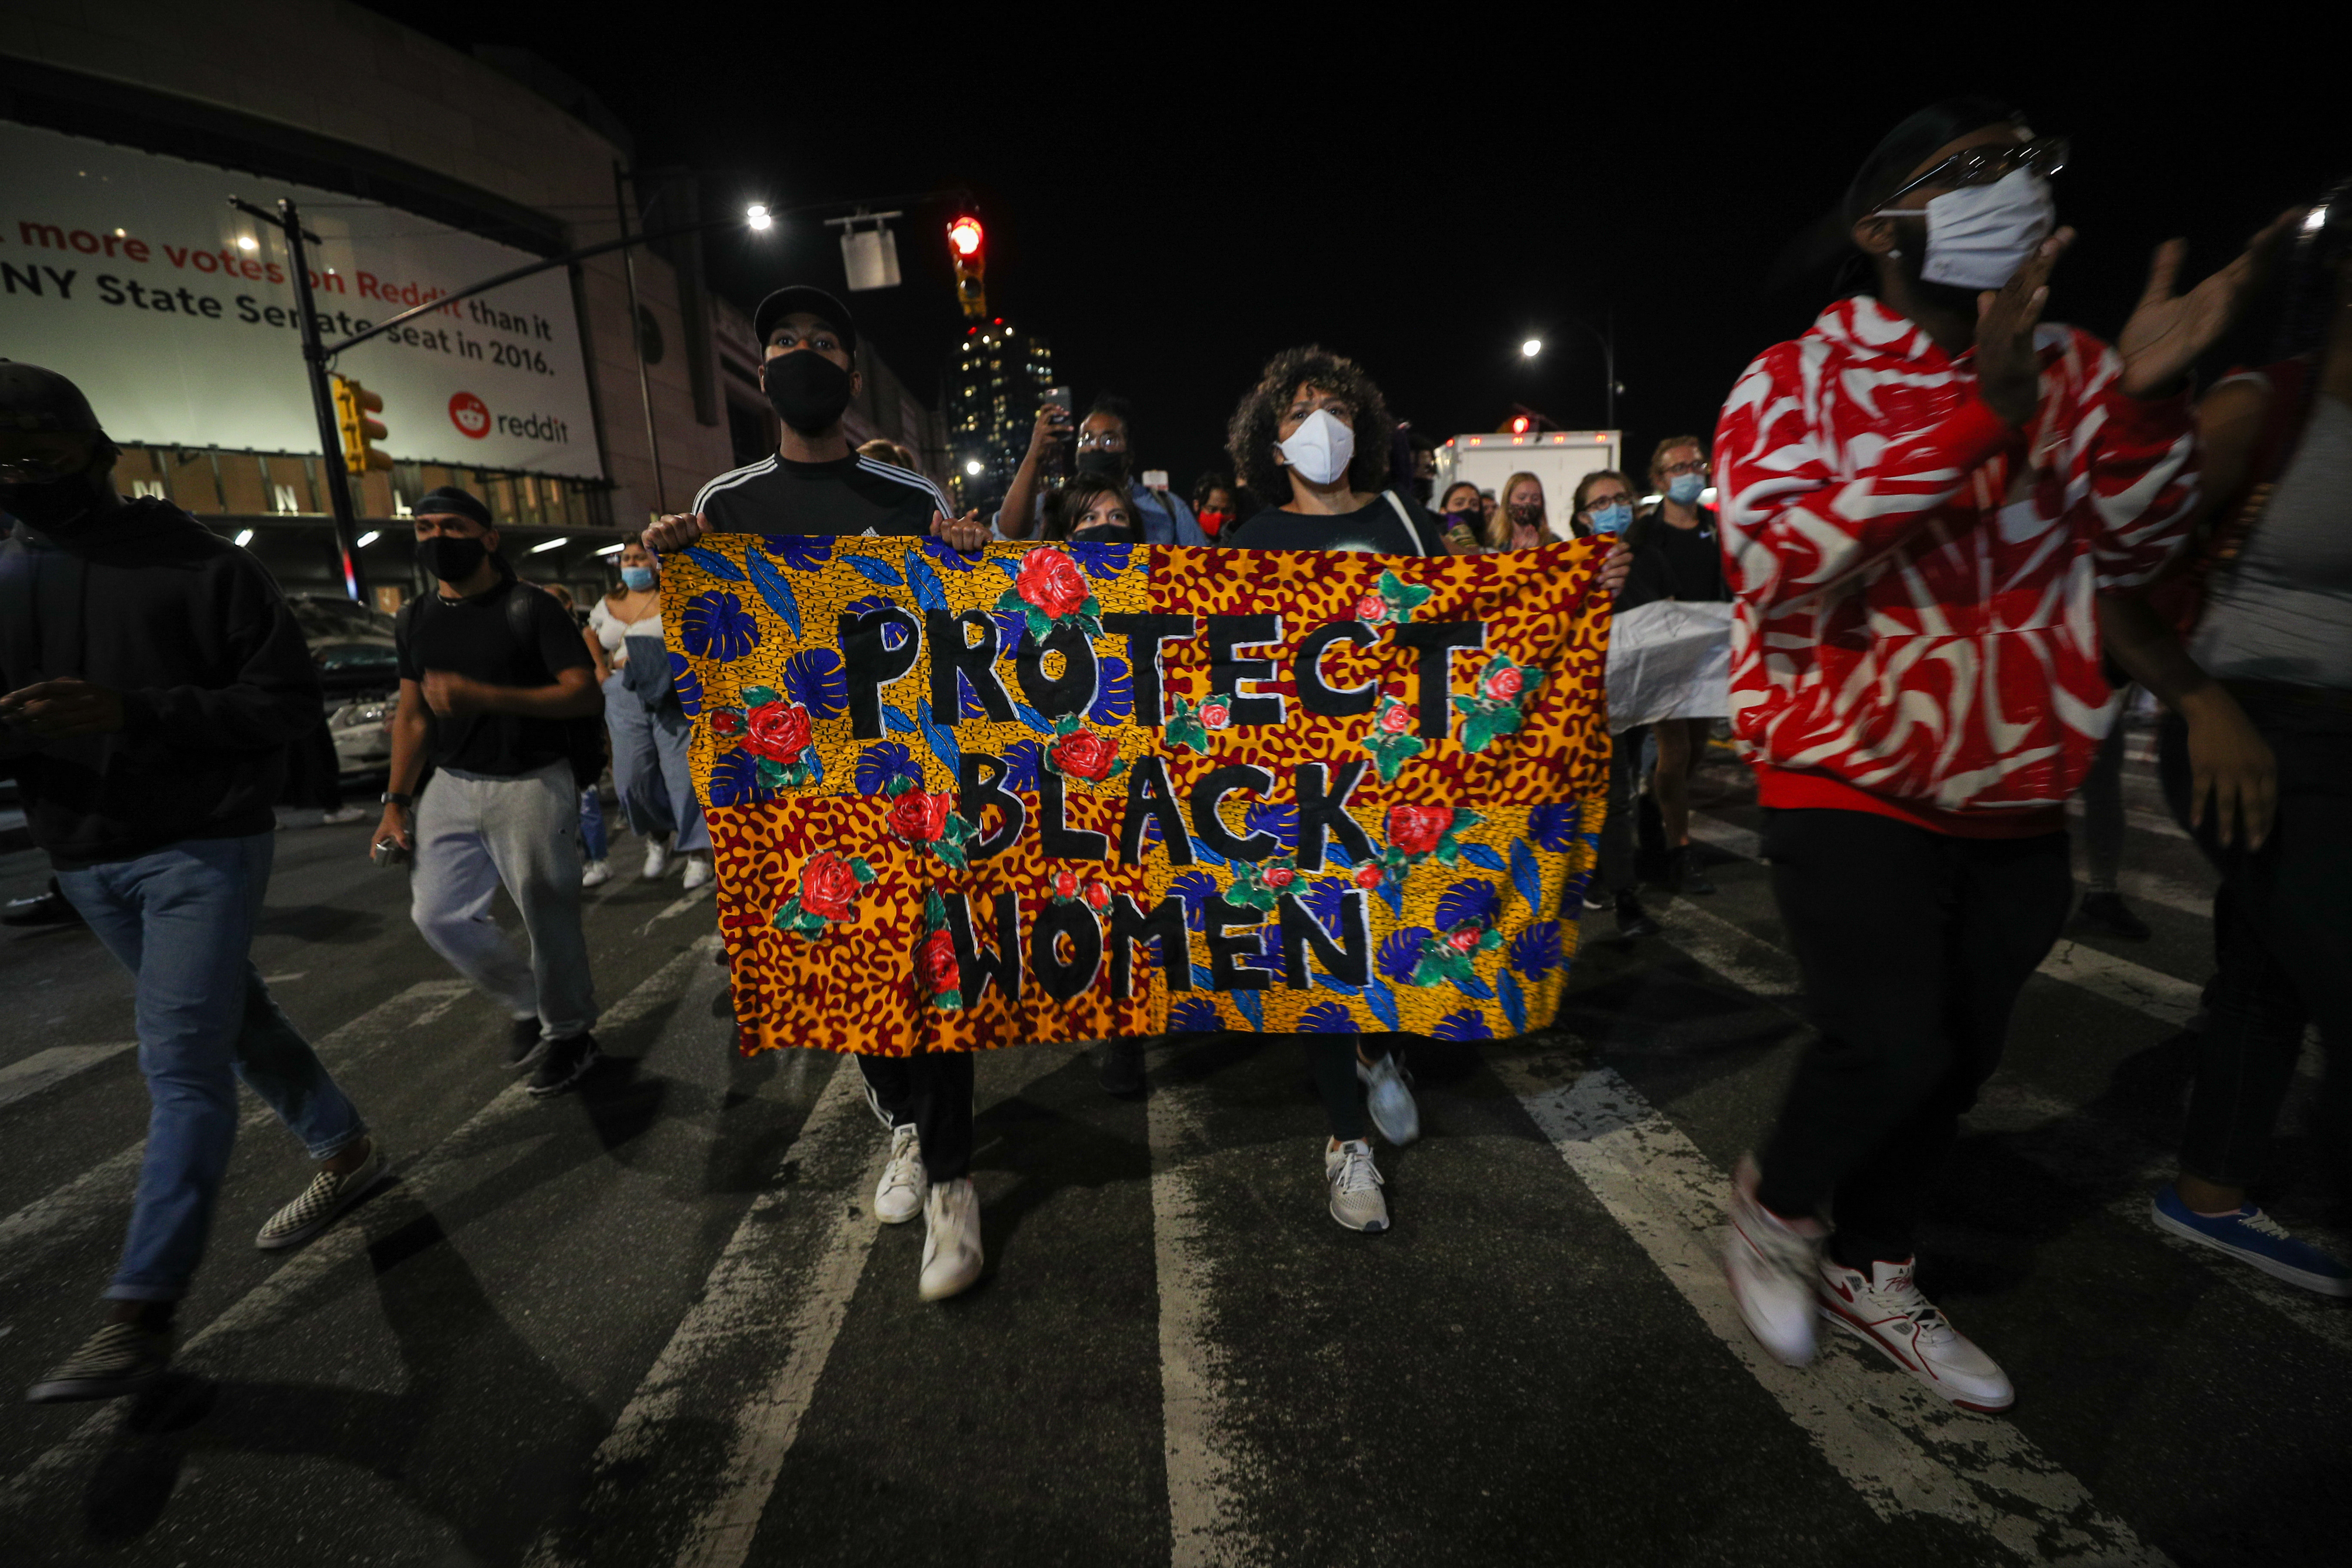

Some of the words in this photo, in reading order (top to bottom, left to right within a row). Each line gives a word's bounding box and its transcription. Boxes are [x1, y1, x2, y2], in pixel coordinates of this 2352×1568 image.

[1, 262, 76, 299] NY
[97, 274, 222, 319] State
[387, 322, 451, 353] seat
[456, 330, 482, 361] in
[489, 340, 554, 376] 2016.
[19, 221, 150, 263] more
[163, 244, 285, 285] votes
[468, 298, 528, 335] than
[533, 313, 553, 341] it
[497, 412, 569, 444] reddit
[838, 605, 1487, 740] PROTECT
[959, 744, 1382, 874] BLACK
[945, 888, 1374, 1008] WOMEN
